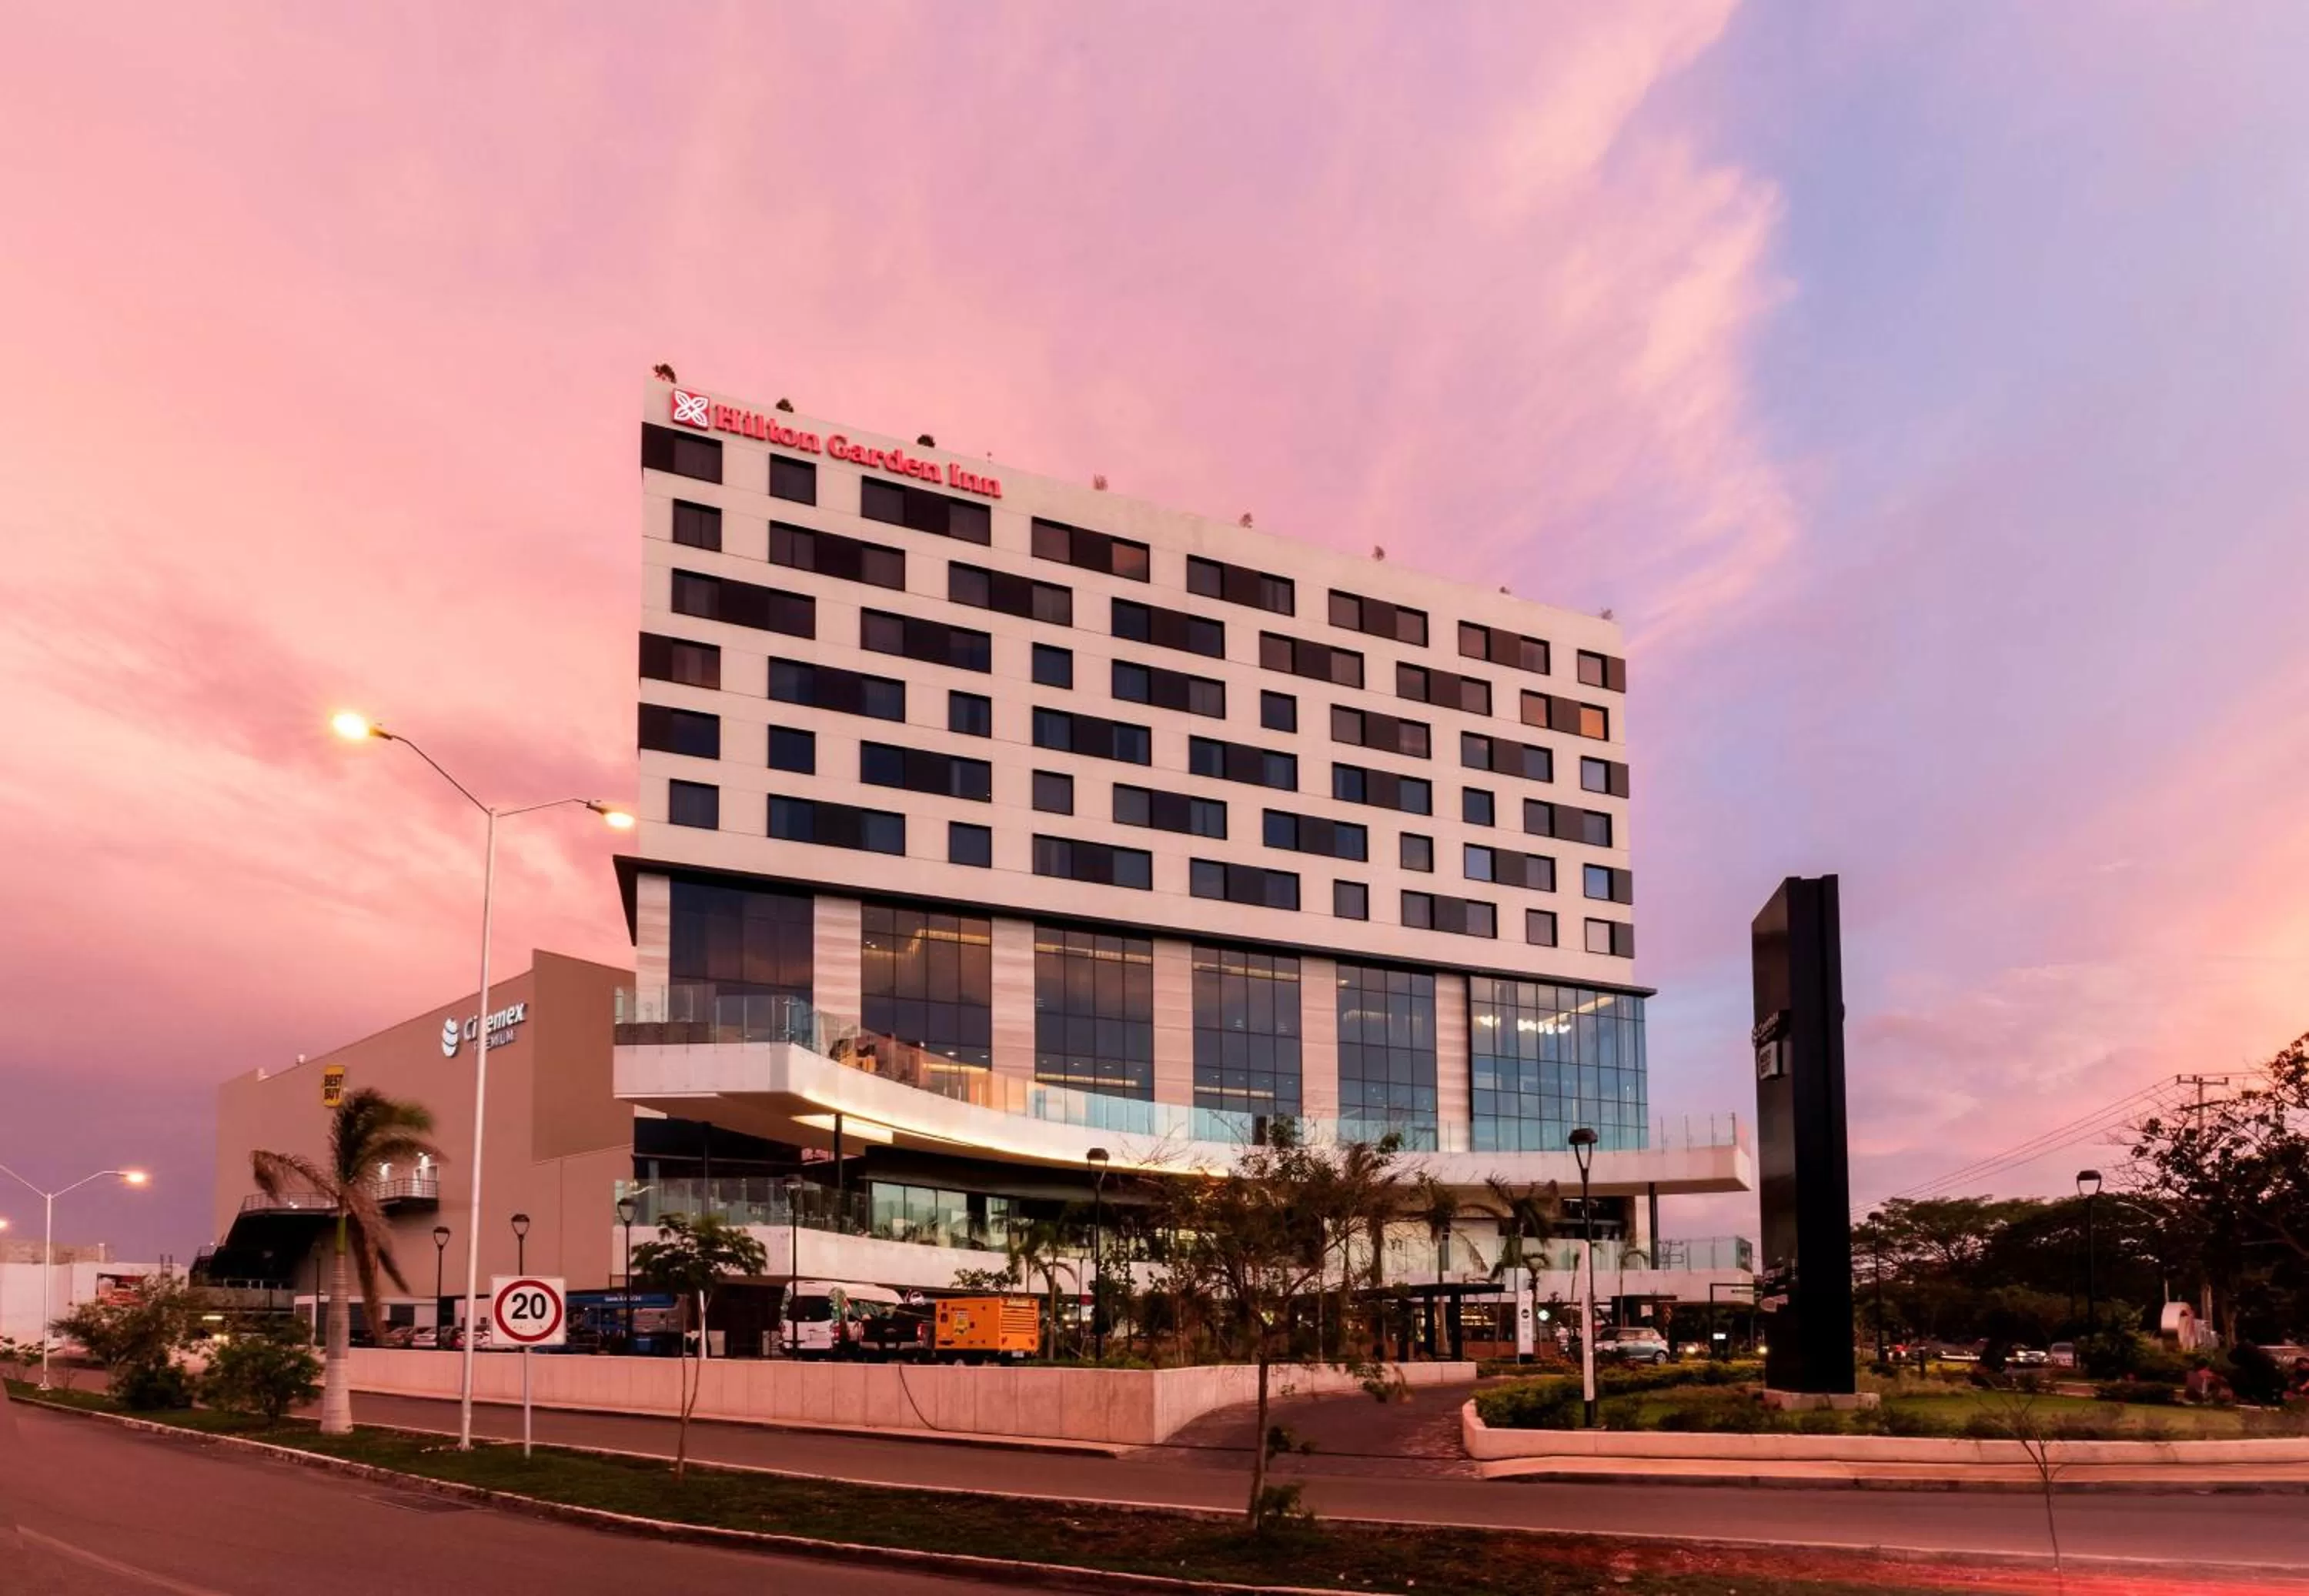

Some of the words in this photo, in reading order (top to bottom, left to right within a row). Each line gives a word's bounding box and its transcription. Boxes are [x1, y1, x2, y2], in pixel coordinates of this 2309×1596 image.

[715, 404, 820, 454] Hilton
[827, 435, 944, 484] Garden
[949, 463, 1003, 498] Inn
[464, 1003, 525, 1040] Ciemex
[324, 1074, 343, 1087] BEST
[324, 1087, 340, 1100] BUY
[511, 1293, 546, 1319] 20
